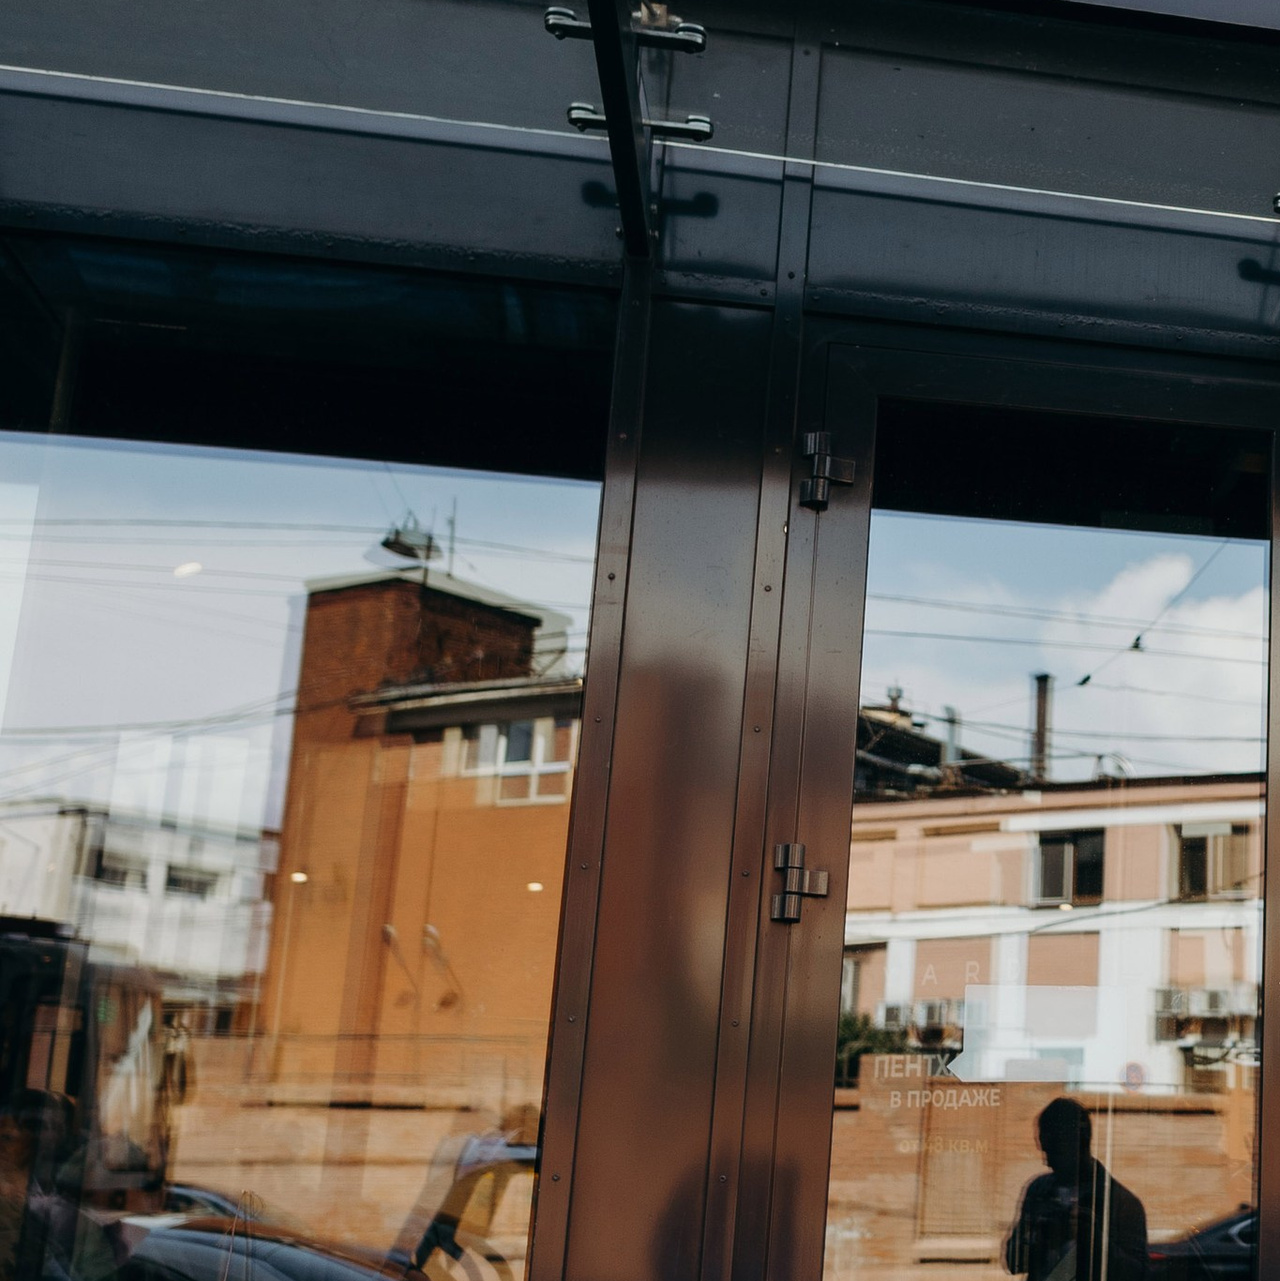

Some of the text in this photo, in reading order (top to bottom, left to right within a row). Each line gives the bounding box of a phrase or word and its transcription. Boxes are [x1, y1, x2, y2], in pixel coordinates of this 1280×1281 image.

[874, 1054, 955, 1079] ПЕНТХ
[890, 1088, 1001, 1111] В ПРОДАЖЕ
